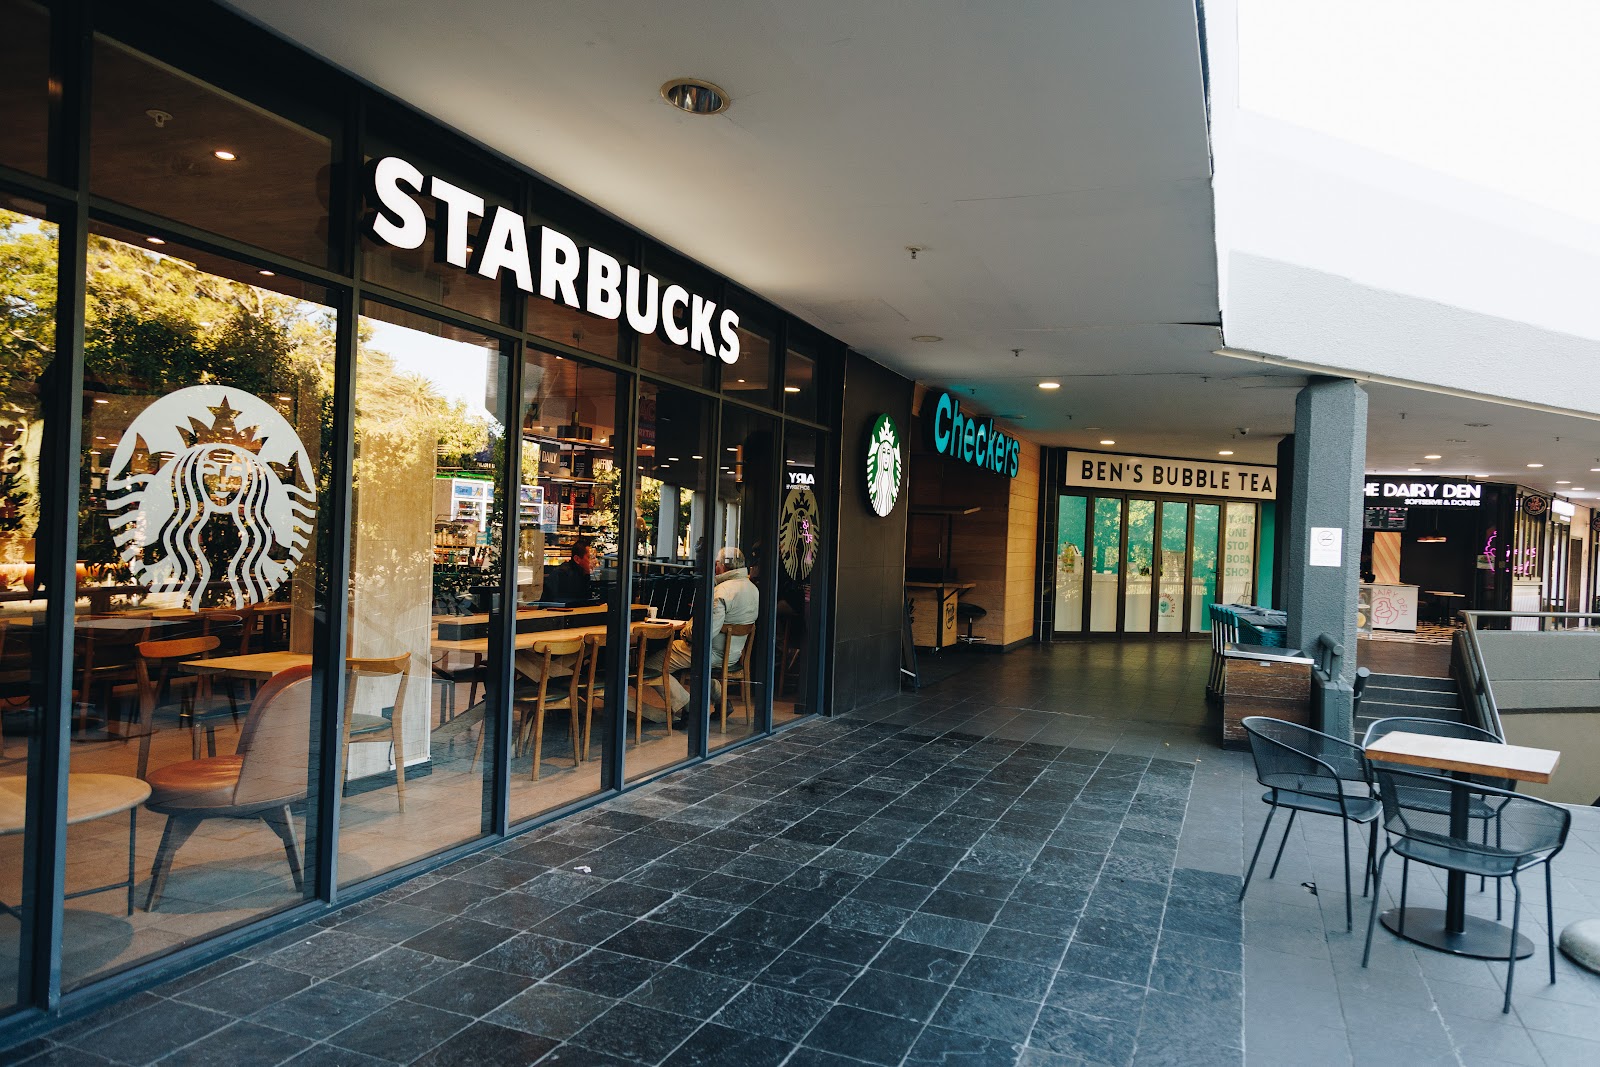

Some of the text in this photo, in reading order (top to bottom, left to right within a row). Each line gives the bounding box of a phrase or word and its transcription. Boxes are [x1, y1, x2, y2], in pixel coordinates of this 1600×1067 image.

[373, 156, 740, 365] STARBUCKS
[934, 393, 1020, 478] Checkers
[542, 450, 558, 464] DAILY
[1081, 459, 1273, 493] BEN'S BUBBLE TEA
[1363, 482, 1481, 499] HE DAIRY DEN
[1404, 498, 1443, 506] SOFTSERVE
[1450, 499, 1481, 507] DONUTS
[1228, 515, 1254, 525] YOUR
[1228, 528, 1247, 538] ONE
[1226, 541, 1249, 551] STOP
[1226, 554, 1251, 564] BOBA
[1225, 567, 1249, 577] SHOP
[1397, 598, 1408, 616] DEN
